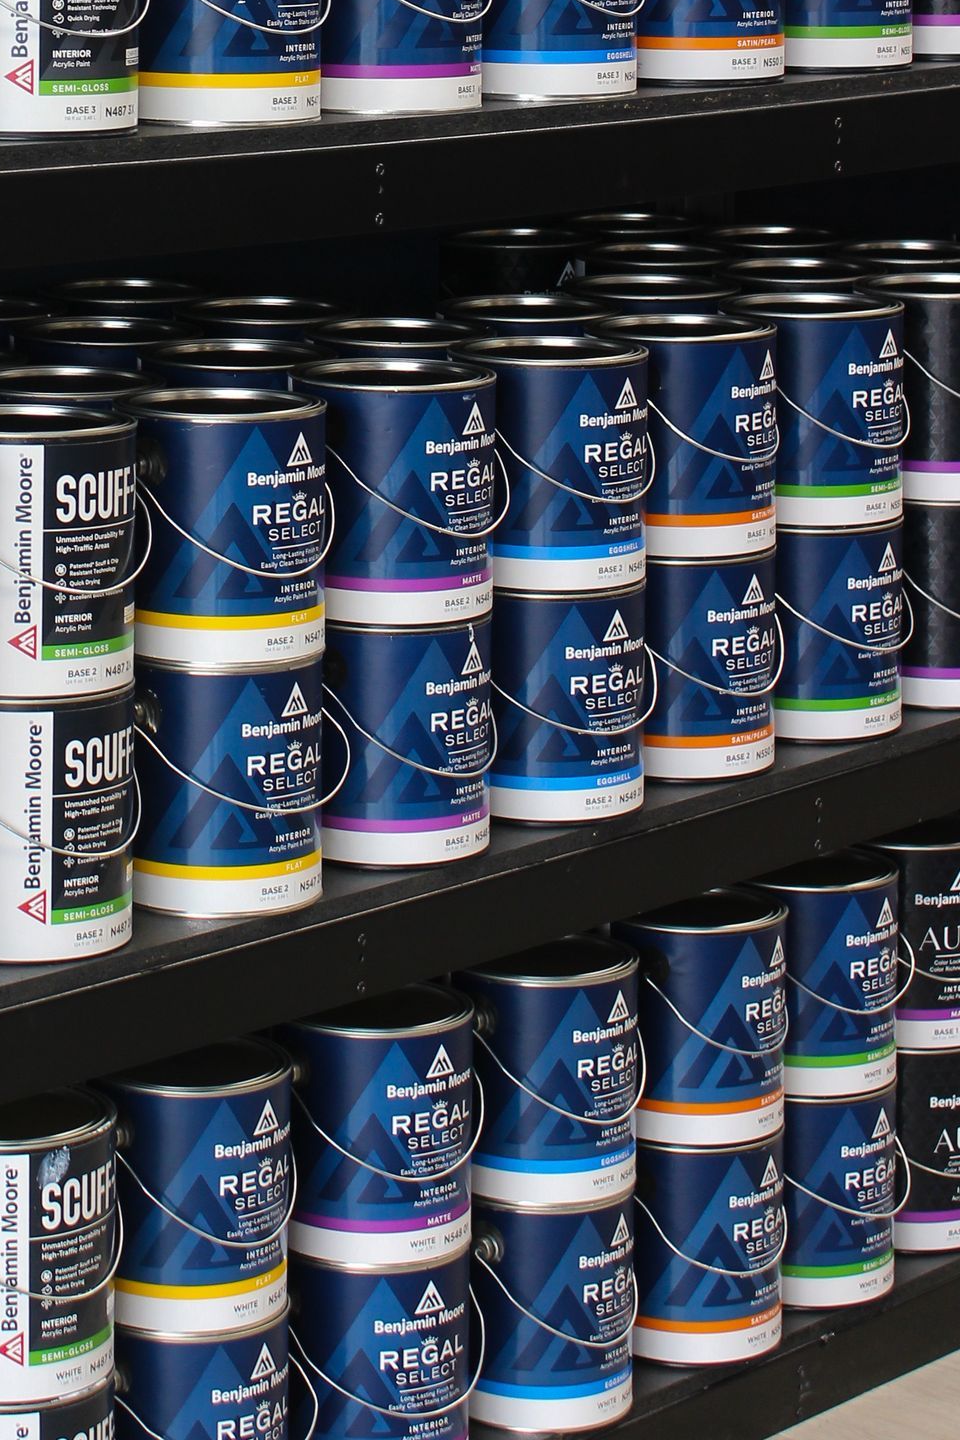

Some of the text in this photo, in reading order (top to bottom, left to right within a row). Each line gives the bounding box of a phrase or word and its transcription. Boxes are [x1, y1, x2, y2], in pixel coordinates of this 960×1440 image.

[737, 38, 776, 47] SATIN/PEARL
[52, 49, 91, 59] INTERIOR
[607, 52, 633, 60] EGGSHELL
[52, 83, 110, 93] SEMI-GLOSS
[272, 97, 297, 105] BASE 3
[252, 495, 324, 526] REGAL
[268, 520, 320, 541] SELECT
[747, 531, 763, 539] BASE
[609, 542, 638, 555] EGGSHELL
[462, 575, 482, 585] MATTE
[445, 598, 464, 608] BASE
[55, 612, 92, 623] INTERIOR
[712, 630, 775, 657] REGAL
[570, 667, 642, 696] REGAL
[597, 773, 630, 786] EGGSHELL
[286, 861, 303, 871] FLAT
[63, 905, 114, 921] SEMI-GLOSS
[934, 1027, 952, 1036] BASE
[864, 1069, 882, 1080] WHITE
[387, 1068, 470, 1100] Benjamin Moore
[427, 1213, 451, 1226] MATTE
[410, 1236, 435, 1249] WHITE
[233, 1299, 258, 1313] WHITE
[747, 1333, 767, 1345] WHITE
[379, 1334, 464, 1371] REGAL
[56, 1366, 82, 1381] WHITE
[409, 1417, 448, 1433] INTERIOR
